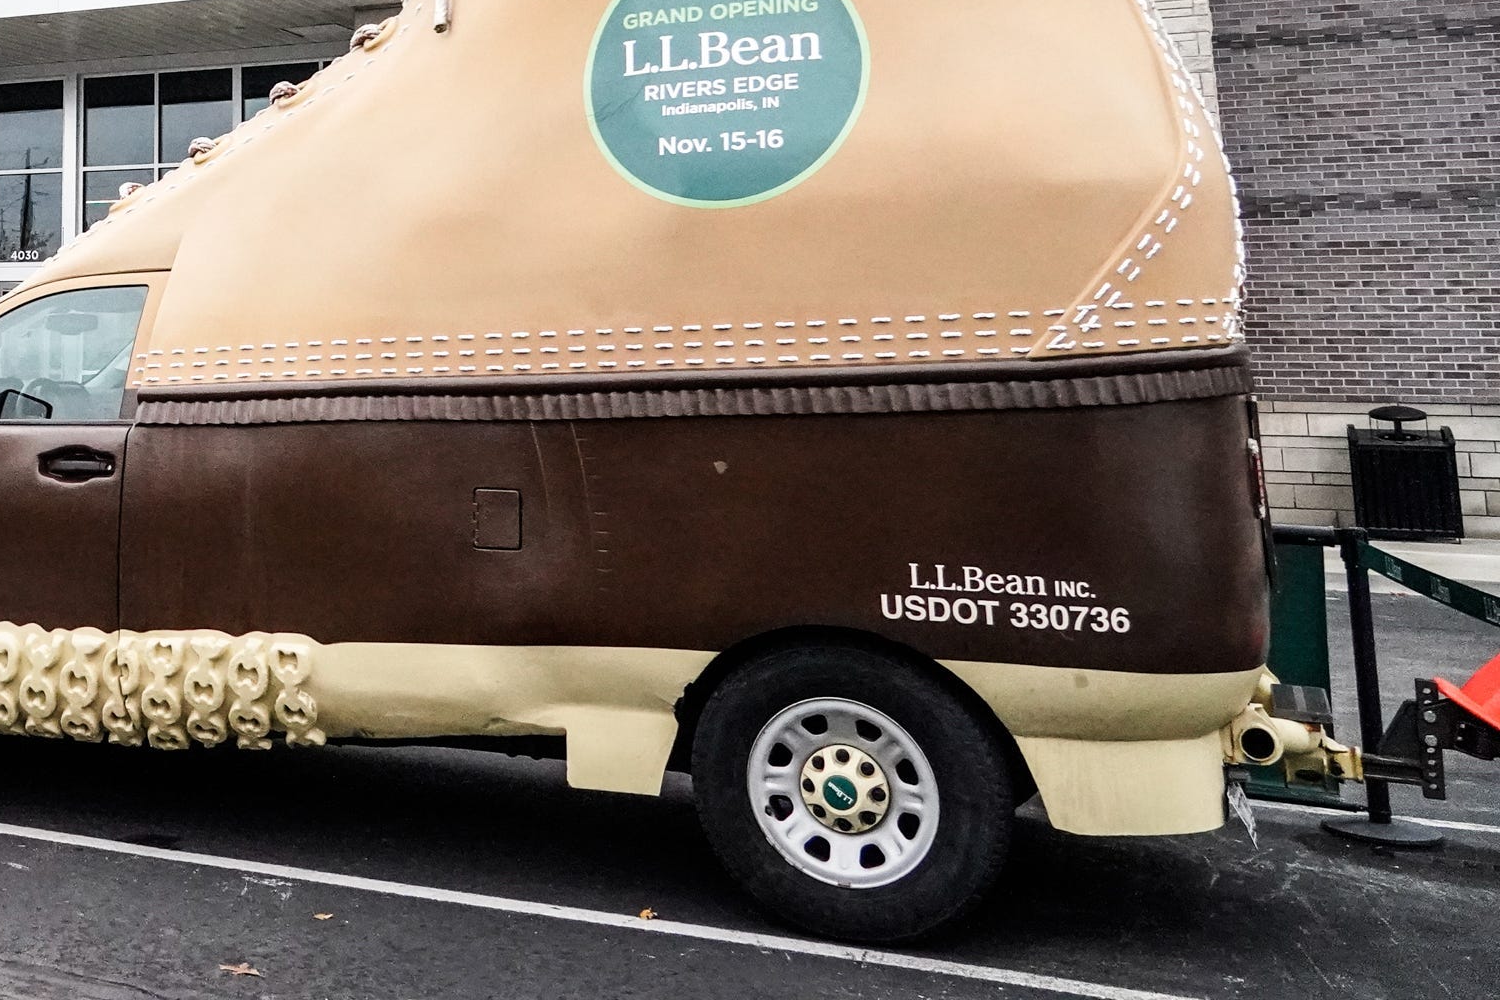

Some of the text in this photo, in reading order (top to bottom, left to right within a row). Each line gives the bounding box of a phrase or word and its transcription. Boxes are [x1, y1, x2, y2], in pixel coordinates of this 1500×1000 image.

[622, 6, 703, 30] GRAND
[622, 29, 823, 77] L.L.Bean
[643, 72, 800, 102] RIVERS EDGE
[660, 96, 780, 117] Indianapolis, IN
[658, 129, 785, 156] Nov. 15-16
[10, 250, 39, 261] 4030
[908, 562, 1097, 599] L.L.Bean INC.
[880, 592, 1131, 634] USDOT 330736
